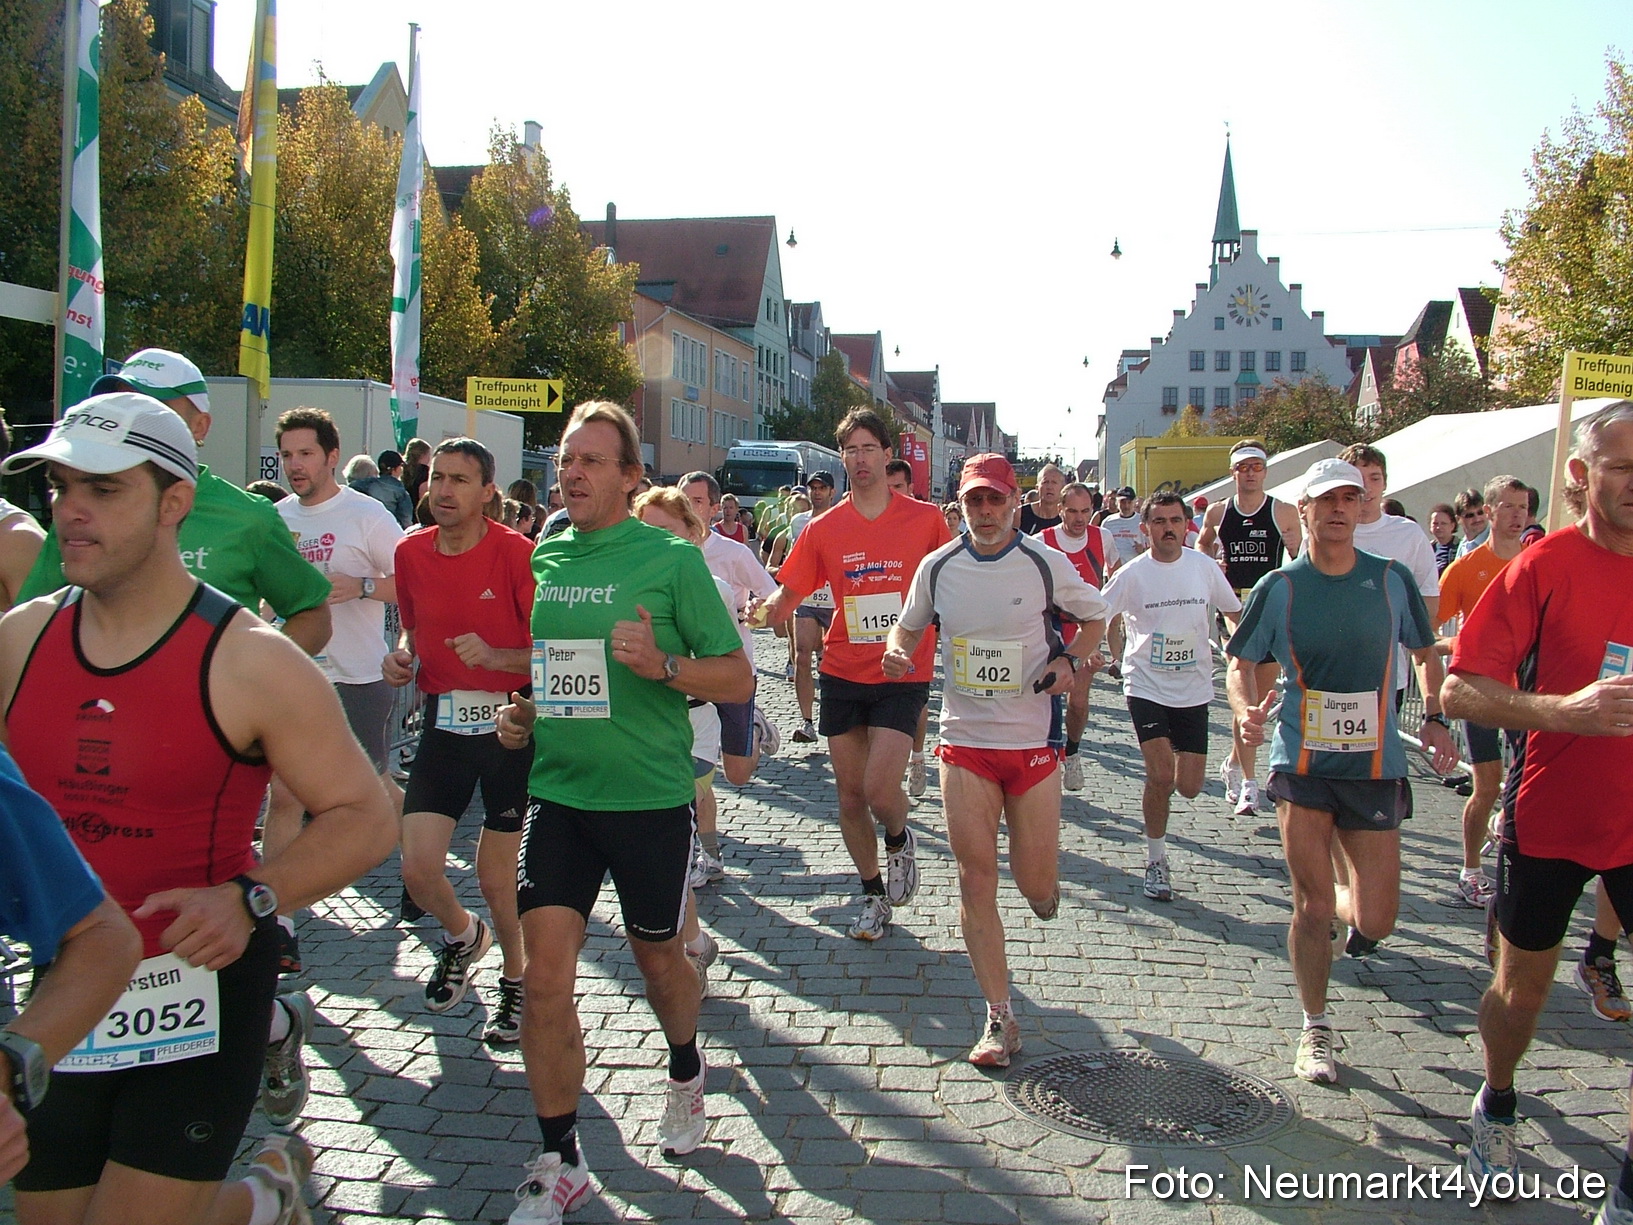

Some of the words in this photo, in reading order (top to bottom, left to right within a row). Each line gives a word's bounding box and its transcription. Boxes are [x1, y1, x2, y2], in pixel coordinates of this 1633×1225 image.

[1576, 357, 1633, 376] Treffpun
[475, 380, 537, 393] Treffpunkt
[474, 395, 541, 409] Bladenight
[1230, 541, 1266, 554] HDI
[855, 563, 866, 571] 28.
[867, 560, 882, 569] Mai
[883, 560, 903, 568] 2006
[536, 581, 616, 609] Sinupret
[813, 593, 829, 602] 852
[862, 614, 898, 629] 1156
[549, 647, 576, 661] Peter
[970, 645, 1002, 659] Jürgen
[1165, 648, 1195, 661] 2381
[976, 666, 1010, 682] 402
[550, 675, 601, 696] 2605
[1324, 698, 1358, 712] Jürgen
[1332, 719, 1367, 735] 194
[107, 998, 206, 1039] 3052
[156, 1037, 216, 1057] PFLEIDERER
